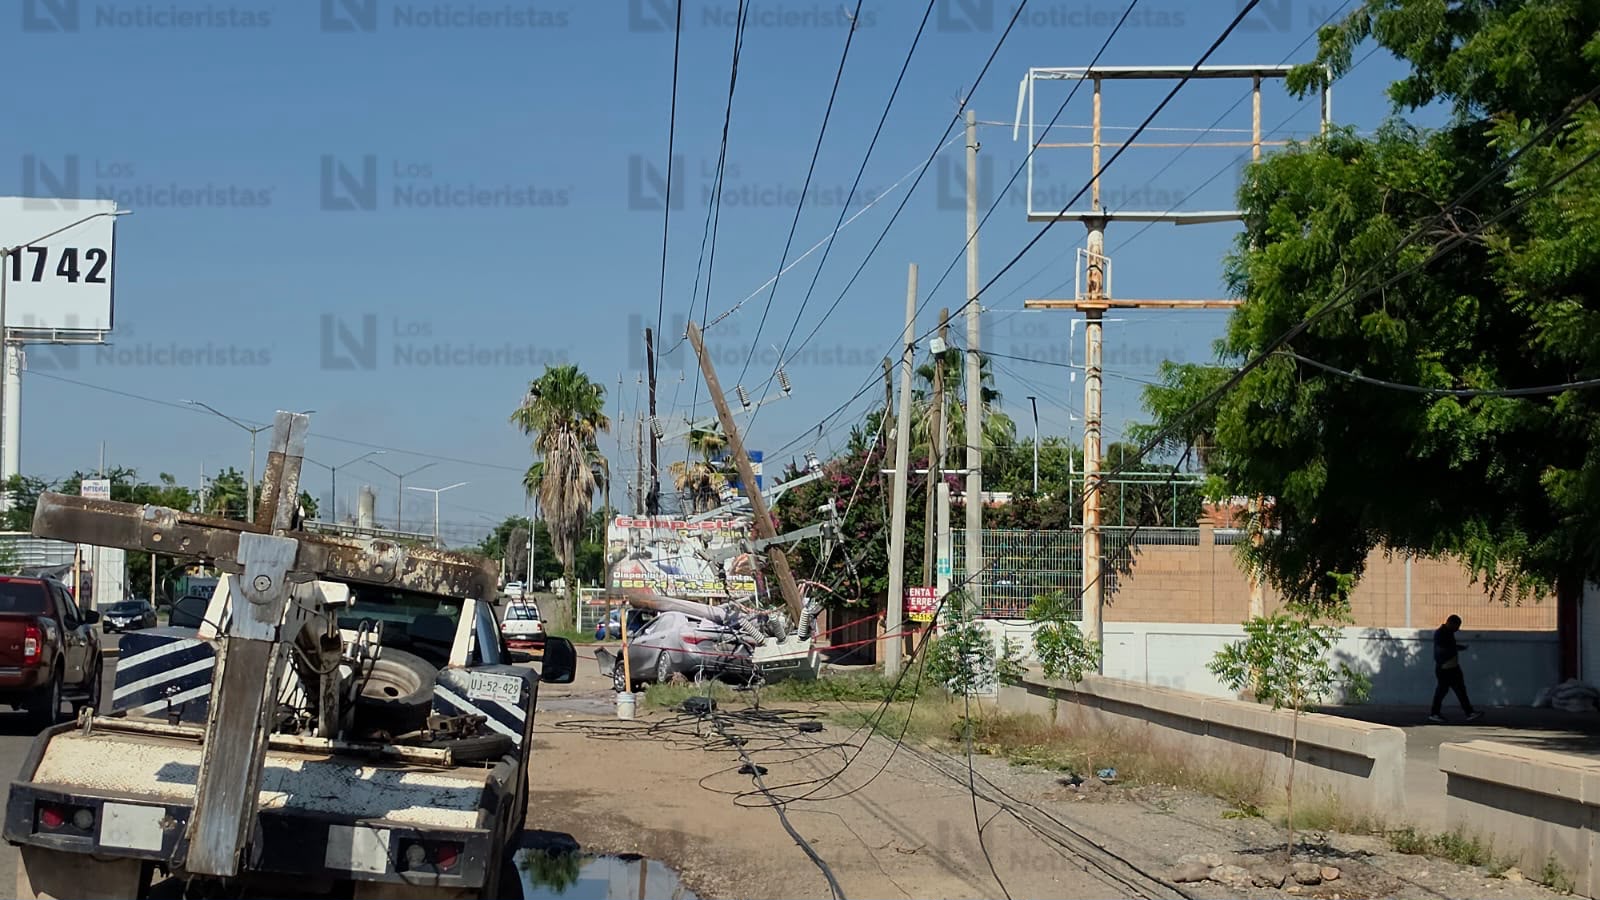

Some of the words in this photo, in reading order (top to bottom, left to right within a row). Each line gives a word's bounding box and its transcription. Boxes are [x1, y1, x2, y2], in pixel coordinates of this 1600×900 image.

[7, 246, 107, 283] 1742
[615, 517, 740, 531] Campestr
[471, 679, 519, 694] UJ-52-429
